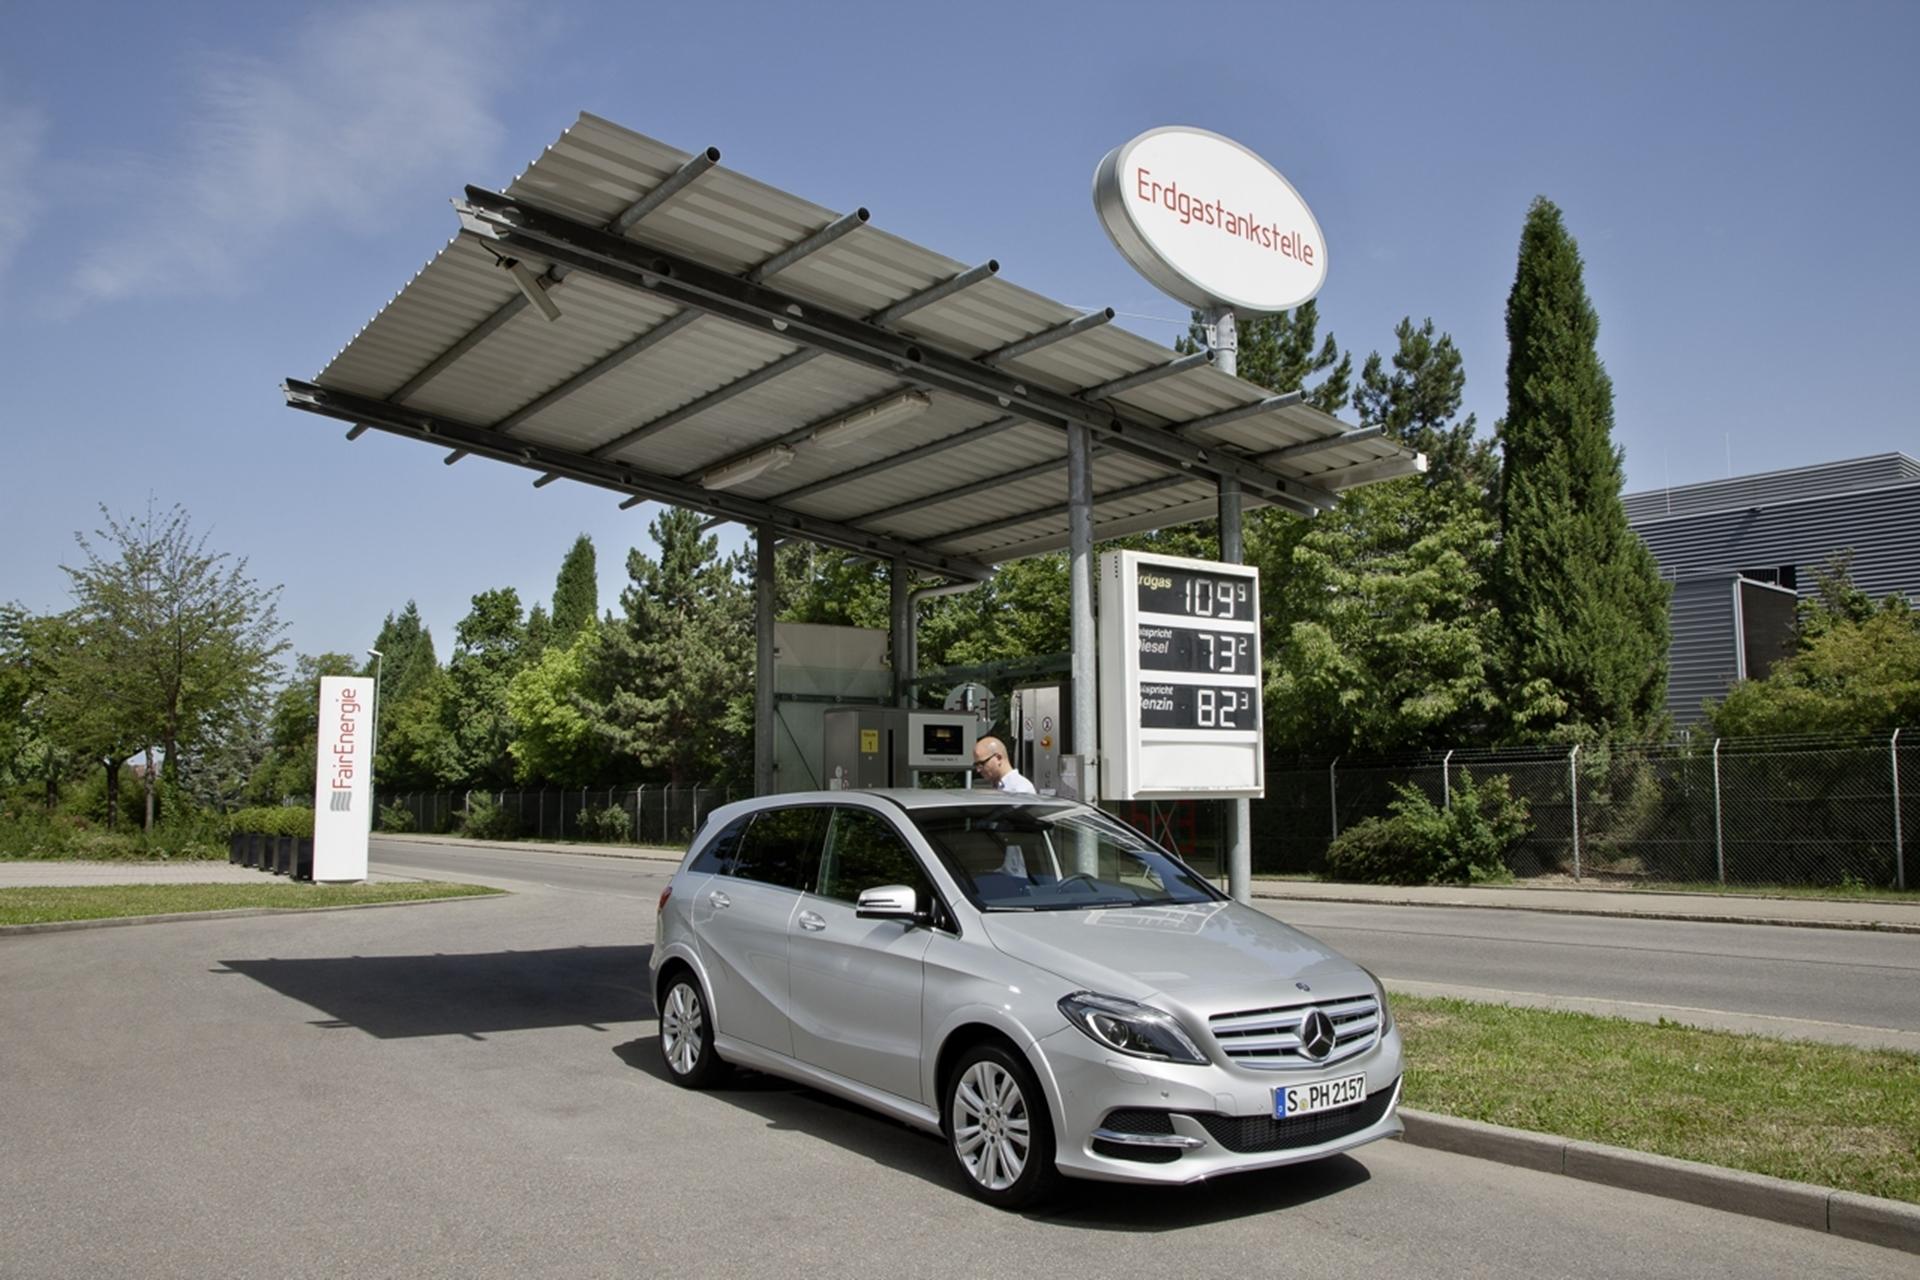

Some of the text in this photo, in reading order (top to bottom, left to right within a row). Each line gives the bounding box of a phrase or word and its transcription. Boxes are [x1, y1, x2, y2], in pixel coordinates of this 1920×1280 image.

[1137, 167, 1313, 266] Erdgastankstelle
[1138, 573, 1172, 590] rdgas
[1140, 697, 1173, 711] enzin
[332, 688, 361, 789] FairEnergie
[1287, 1090, 1298, 1112] S
